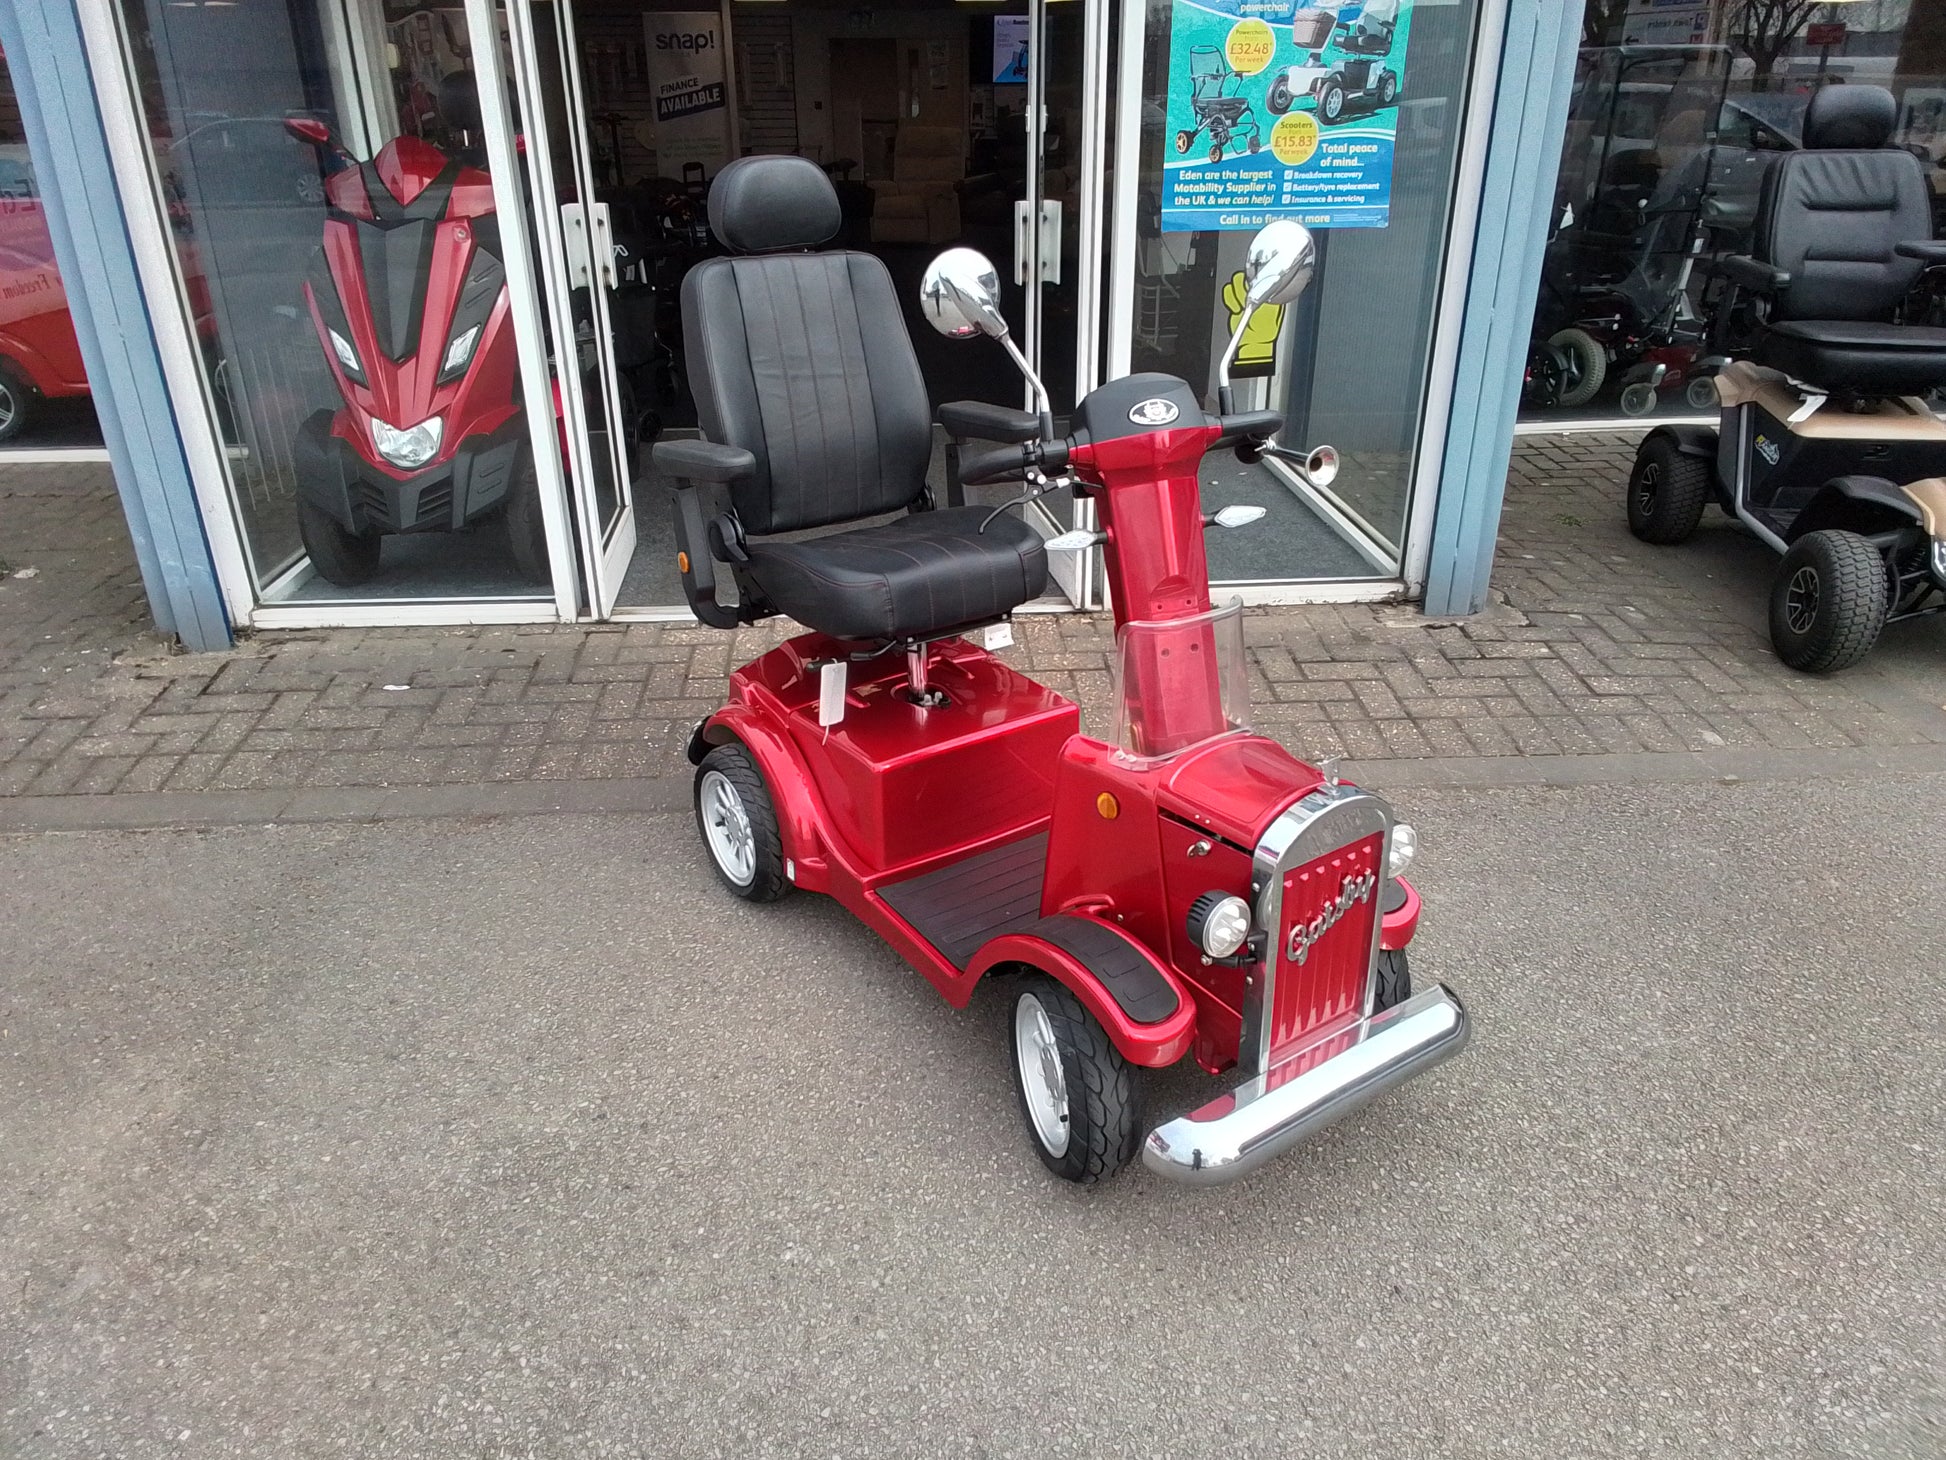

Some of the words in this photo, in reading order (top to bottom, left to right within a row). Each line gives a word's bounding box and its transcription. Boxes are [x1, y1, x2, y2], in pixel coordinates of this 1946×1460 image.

[1240, 2, 1290, 13] powerchair
[656, 30, 714, 54] snap!
[660, 77, 699, 96] FINANCE
[661, 87, 721, 114] AVAILABLE
[1280, 121, 1312, 129] Scooters
[1321, 143, 1347, 153] Total
[1349, 144, 1378, 155] peace
[1320, 156, 1332, 167] of
[1179, 170, 1202, 180] Eden
[1204, 171, 1220, 180] are
[1222, 169, 1238, 179] the
[1240, 169, 1273, 181] largest
[1293, 171, 1332, 179] Breakdown
[1333, 171, 1363, 180] recovery
[1174, 182, 1224, 194] Motability
[1226, 181, 1265, 194] Supplier
[1267, 182, 1276, 191] in
[1292, 183, 1335, 192] Battery/tyre
[1336, 182, 1380, 192] replacement
[1174, 195, 1190, 205] the
[1192, 195, 1206, 205] UK
[1208, 194, 1216, 205] &
[1232, 196, 1248, 204] can
[1251, 194, 1274, 206] help!
[1291, 195, 1326, 203] Insurance
[1326, 195, 1333, 203] &
[1333, 195, 1365, 203] servicing
[1220, 214, 1238, 225] Call
[1240, 215, 1250, 224] in
[1252, 214, 1263, 224] to
[1305, 214, 1331, 223] more
